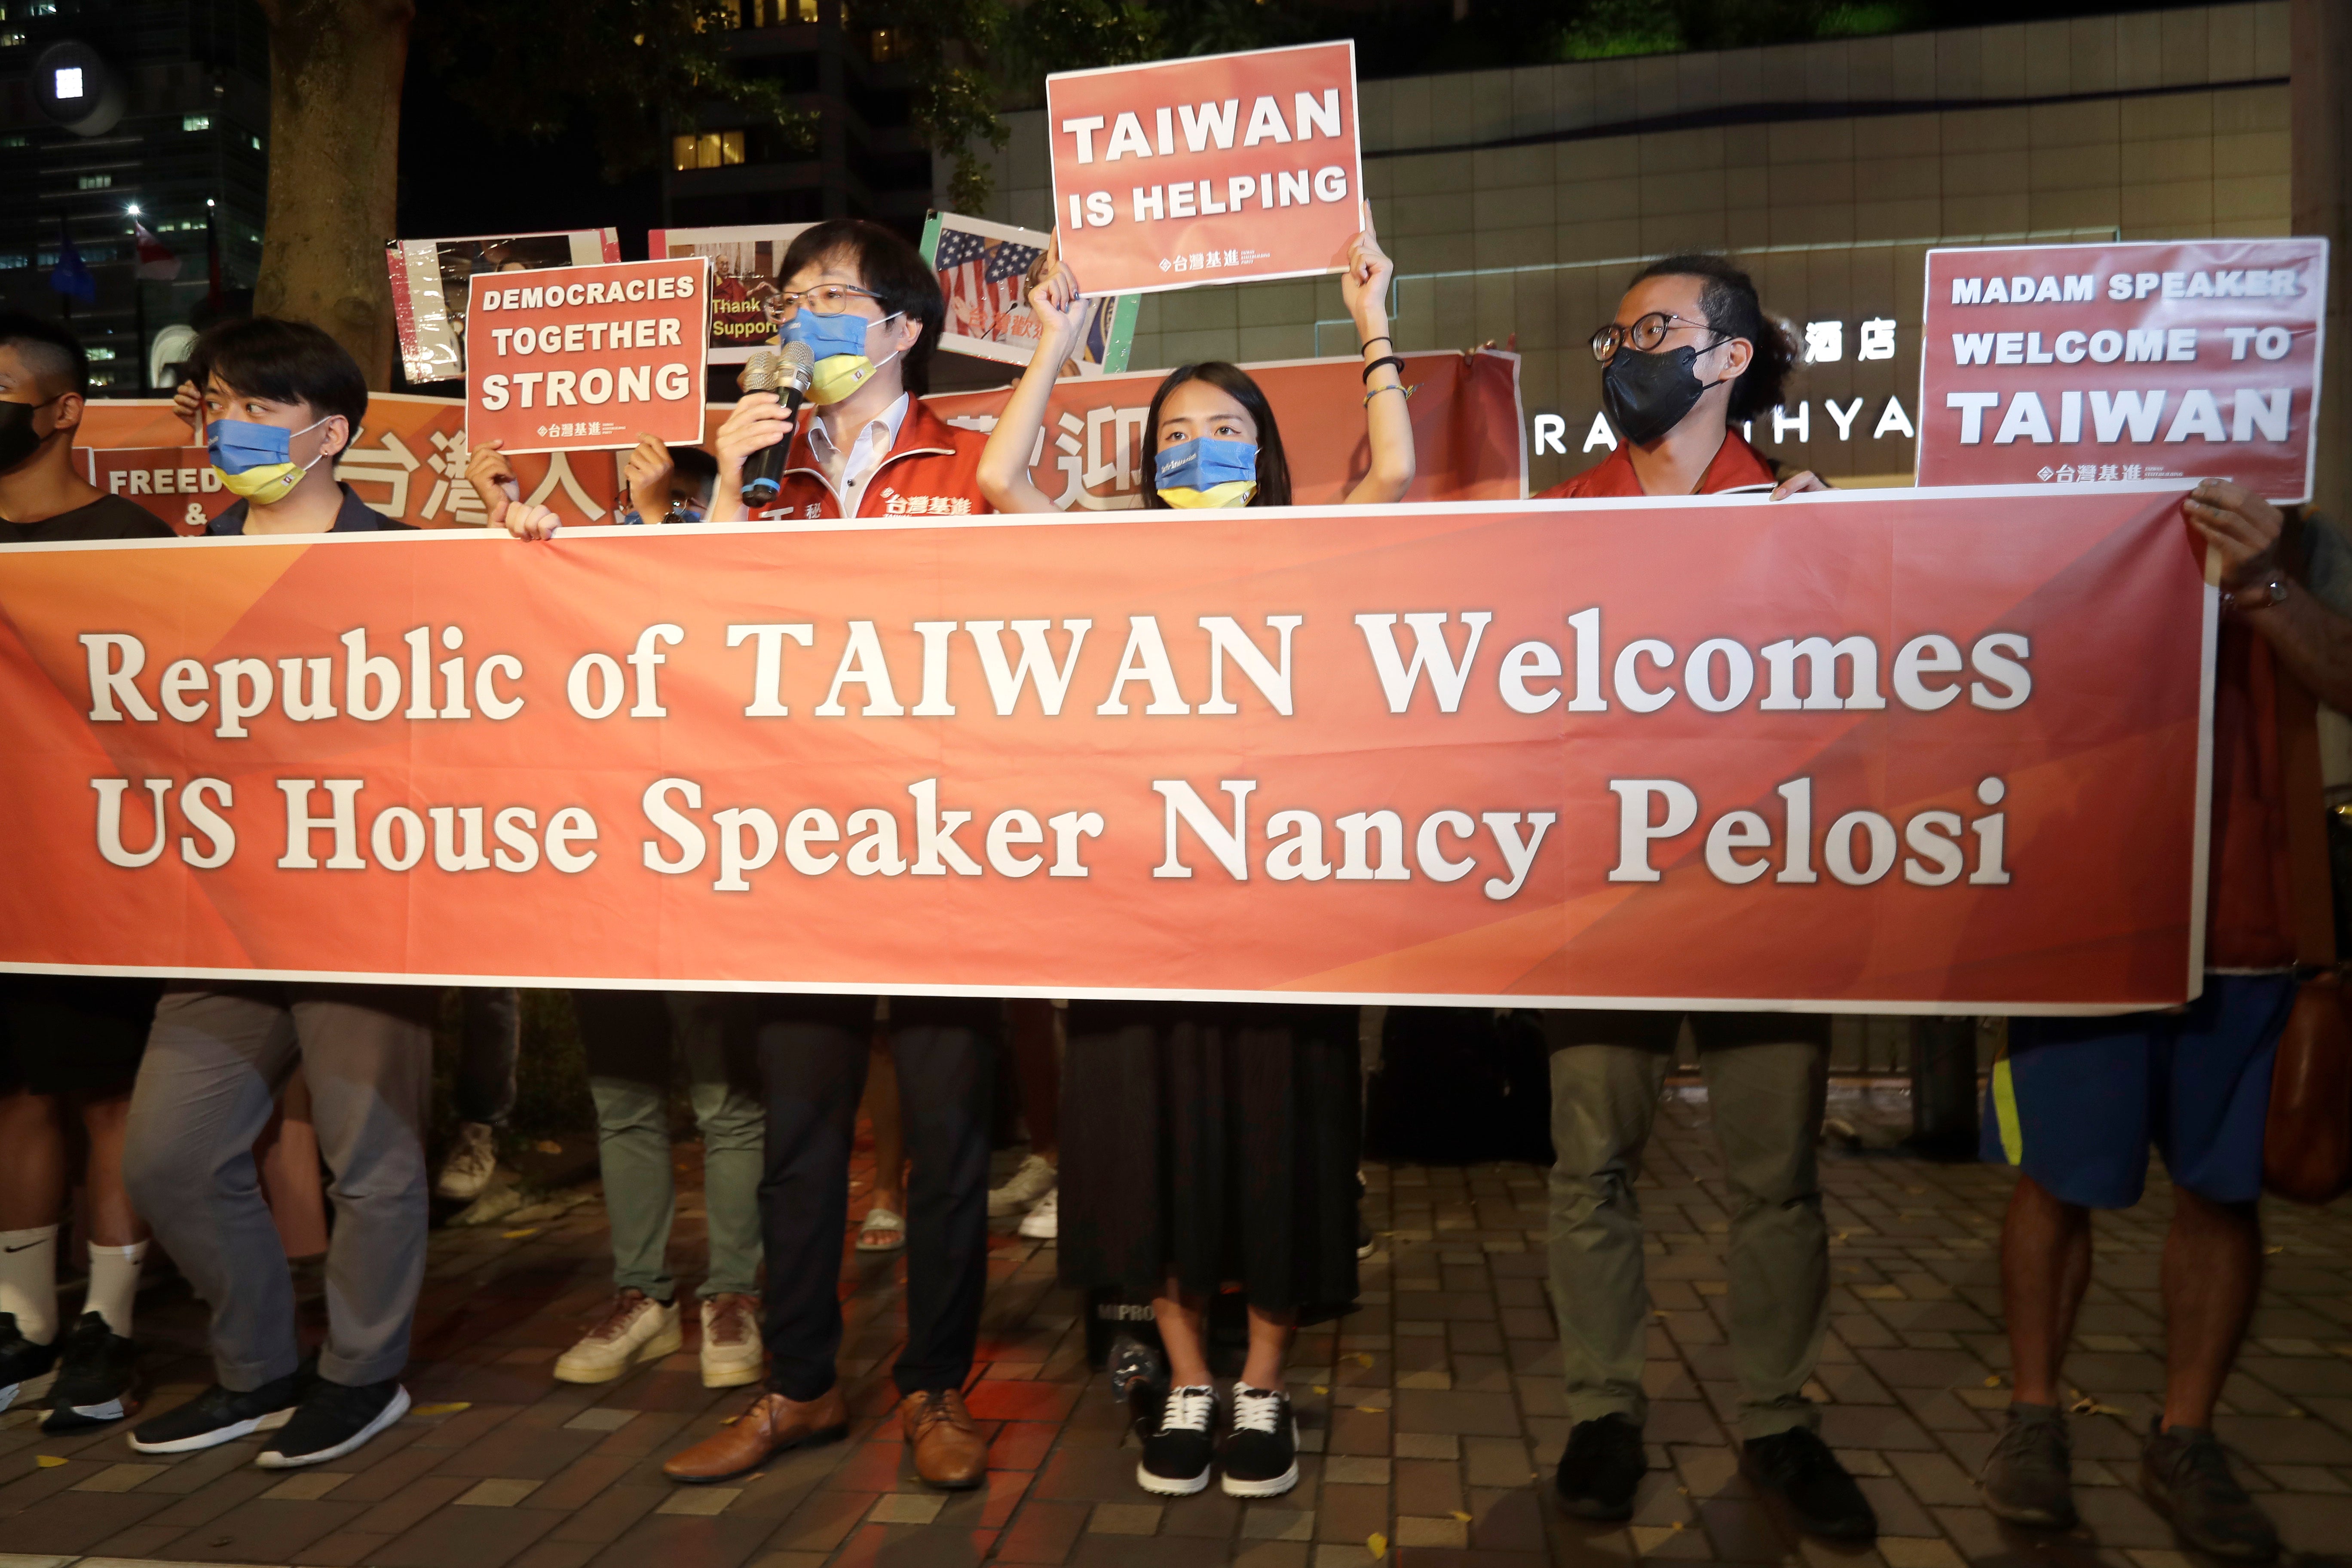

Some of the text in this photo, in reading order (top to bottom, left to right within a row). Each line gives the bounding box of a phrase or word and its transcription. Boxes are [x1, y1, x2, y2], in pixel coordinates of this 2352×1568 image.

[1063, 88, 1341, 165] TAIWAN
[1069, 165, 1348, 230] IS HELPING
[1173, 249, 1240, 272] 台灣基進
[482, 276, 694, 311] DEMOCRACIES
[712, 297, 761, 314] Thank
[1951, 269, 2299, 305] MADAM SPEAKER
[491, 318, 683, 356] TOGETHER
[1805, 317, 1896, 363] 酒店
[1951, 327, 2292, 365] WELCOME TO
[481, 363, 690, 411] STRONG
[548, 422, 601, 438] 台灣基進
[1773, 395, 1915, 444] HYA
[1946, 388, 2292, 444] TAIWAN
[110, 468, 223, 495] FREED
[2056, 464, 2142, 482] 台灣基進
[185, 502, 208, 525] &
[885, 494, 972, 515] 台灣基進
[80, 605, 2031, 738] Republic of TAIWAN Welcomes
[91, 777, 2010, 900] US House Speaker Nancy Pelosi
[1098, 1304, 1155, 1321] MIPRO
